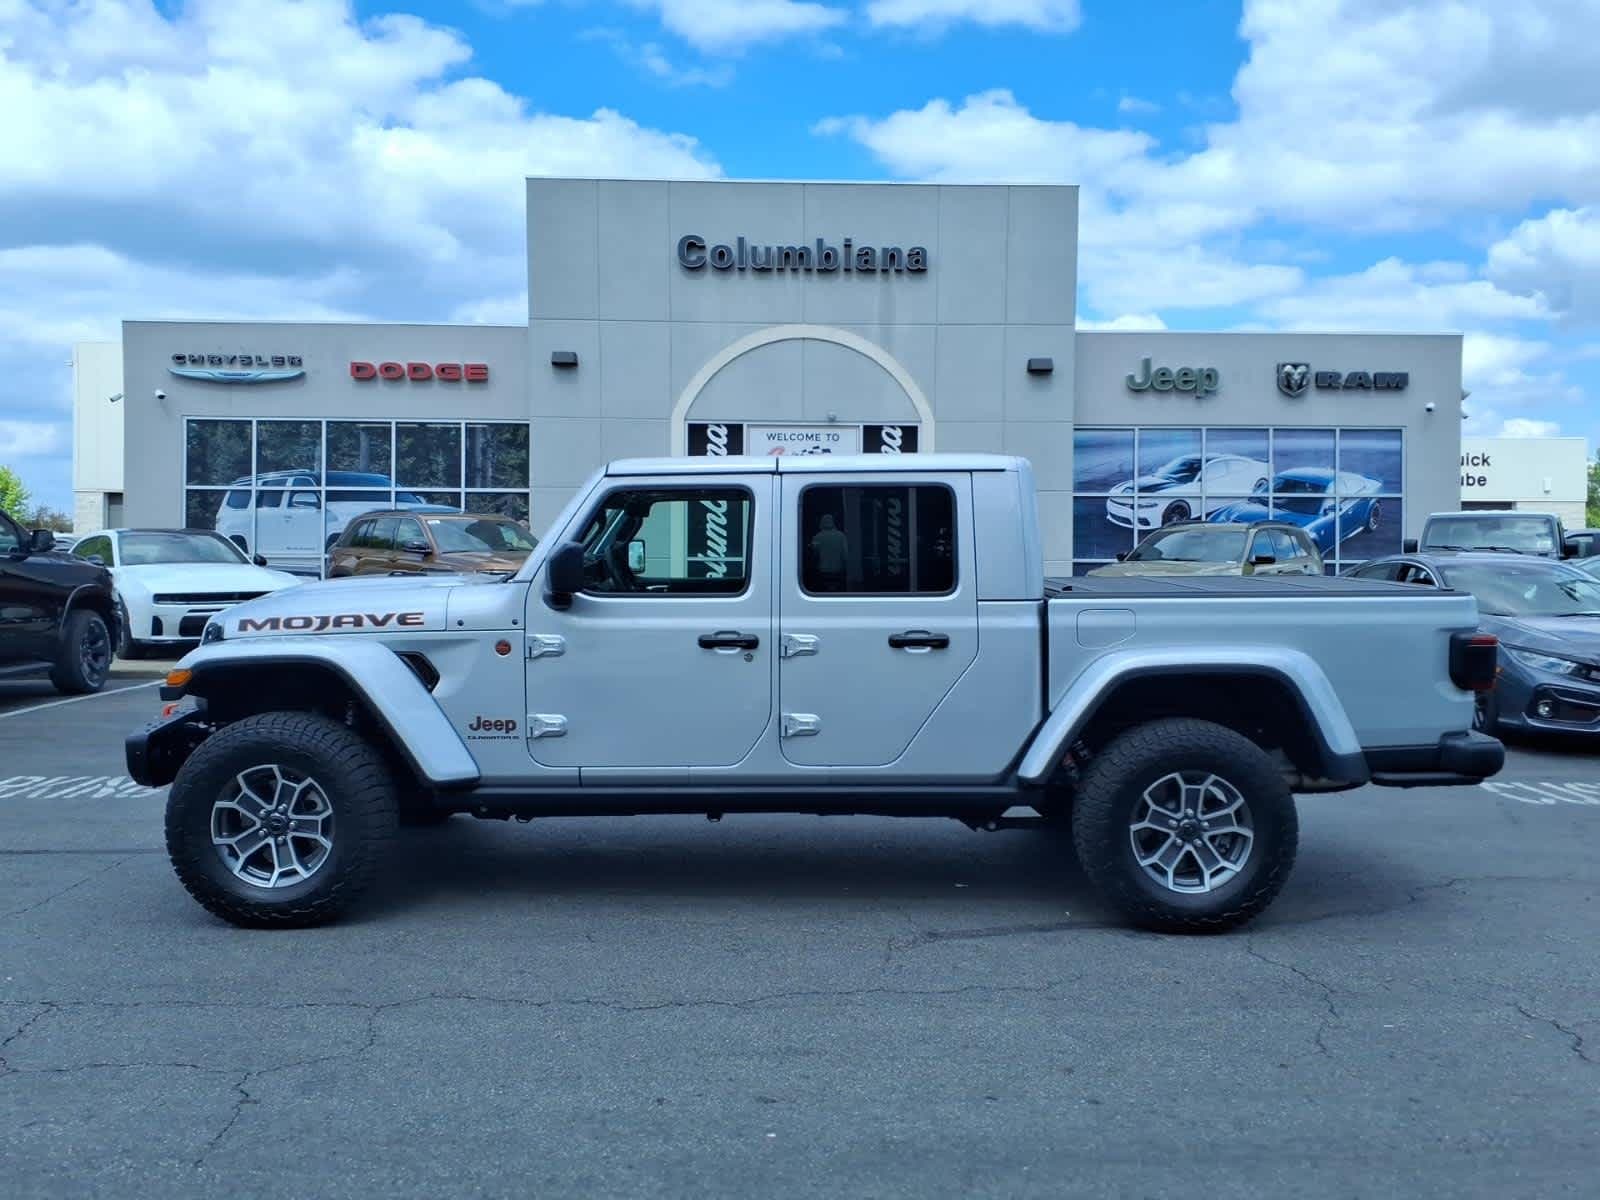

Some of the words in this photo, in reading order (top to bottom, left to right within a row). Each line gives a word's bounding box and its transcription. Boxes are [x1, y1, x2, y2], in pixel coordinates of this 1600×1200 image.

[677, 235, 928, 271] Columbiana
[172, 353, 303, 367] CHRYSLER
[350, 361, 489, 382] DODGE
[1126, 357, 1219, 399] Jeep
[1315, 371, 1409, 389] RAM
[766, 432, 821, 442] WELCOME
[826, 433, 840, 442] TO
[238, 612, 425, 632] MOJAVE
[469, 716, 517, 734] Jeep
